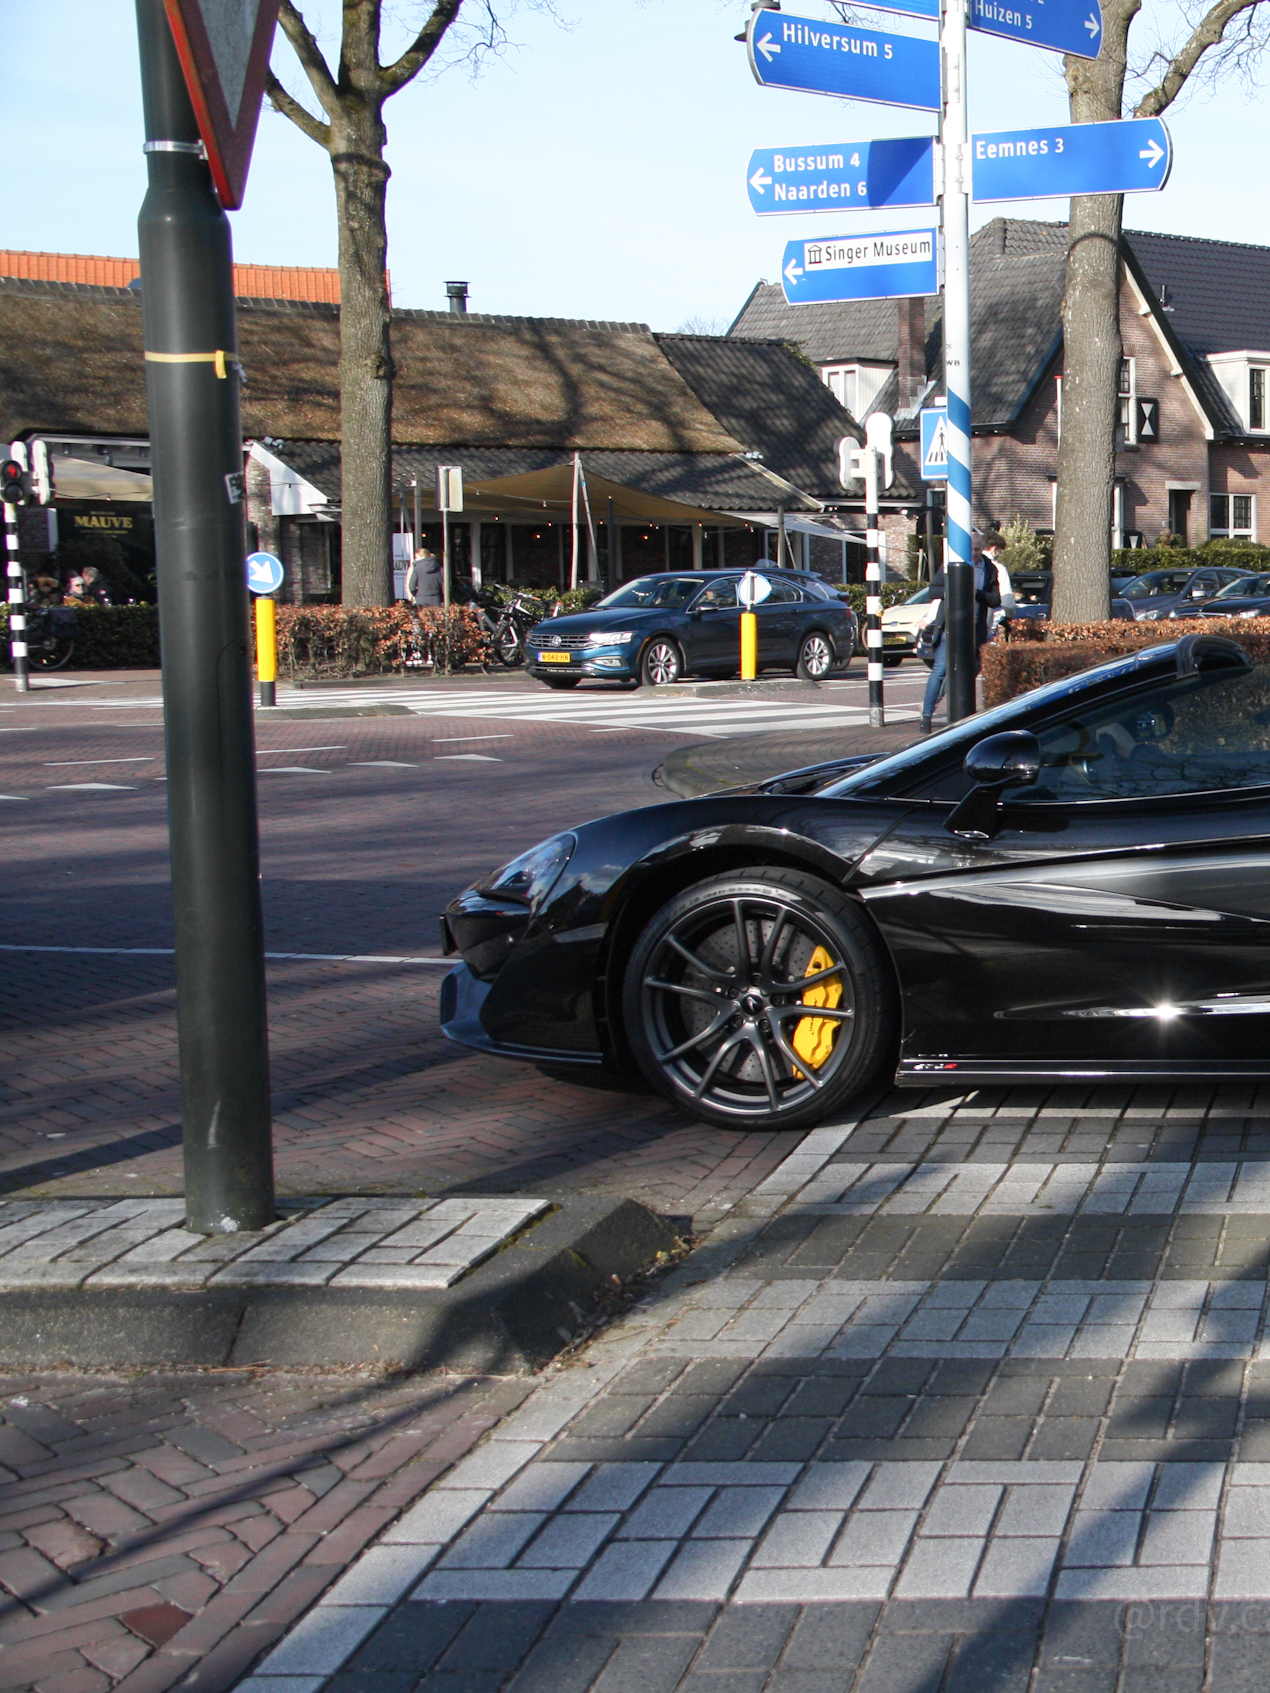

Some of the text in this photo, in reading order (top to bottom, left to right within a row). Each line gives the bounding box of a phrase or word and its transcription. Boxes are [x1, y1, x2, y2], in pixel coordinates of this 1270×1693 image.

[975, 0, 1032, 29] Huizen 5
[783, 22, 893, 59] Hilversum 5
[976, 138, 1064, 159] Eemnes 3
[774, 152, 860, 172] Bussum 4
[774, 180, 867, 201] Naarden 6
[825, 240, 931, 264] Singer Museum
[74, 516, 133, 528] MAUVE
